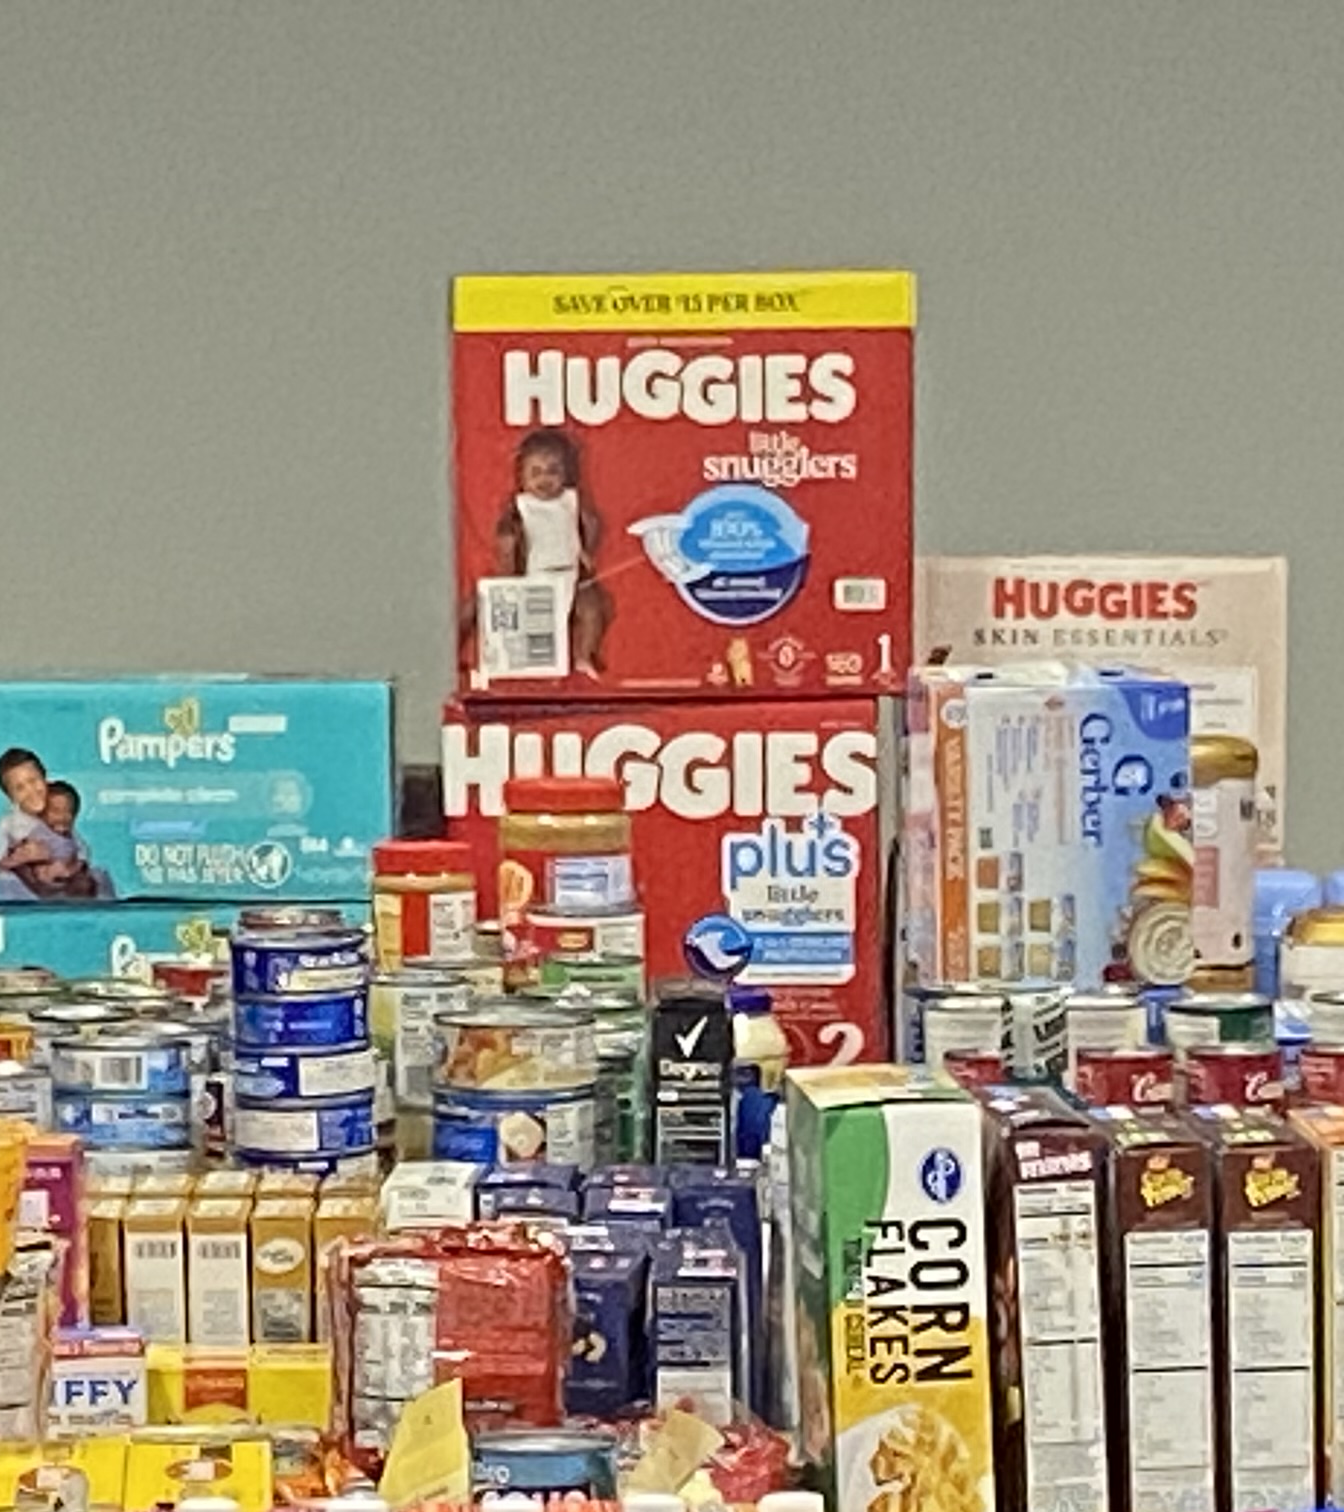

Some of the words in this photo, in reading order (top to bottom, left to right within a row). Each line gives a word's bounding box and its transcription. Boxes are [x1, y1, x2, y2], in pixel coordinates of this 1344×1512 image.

[553, 293, 607, 315] SAVE
[707, 292, 749, 314] PER
[754, 290, 802, 314] BOX
[503, 349, 857, 426] HUGGIES
[702, 447, 858, 487] snugglers
[749, 431, 802, 453] little
[993, 577, 1200, 621] HUGGIES
[972, 627, 1040, 647] SKIN
[1052, 628, 1222, 647] ESSENTIALS
[97, 716, 236, 768] Pampers
[1080, 712, 1113, 848] Gerber
[730, 824, 852, 891] plus
[864, 1219, 910, 1385] FLAKES
[908, 1217, 975, 1382] CORN
